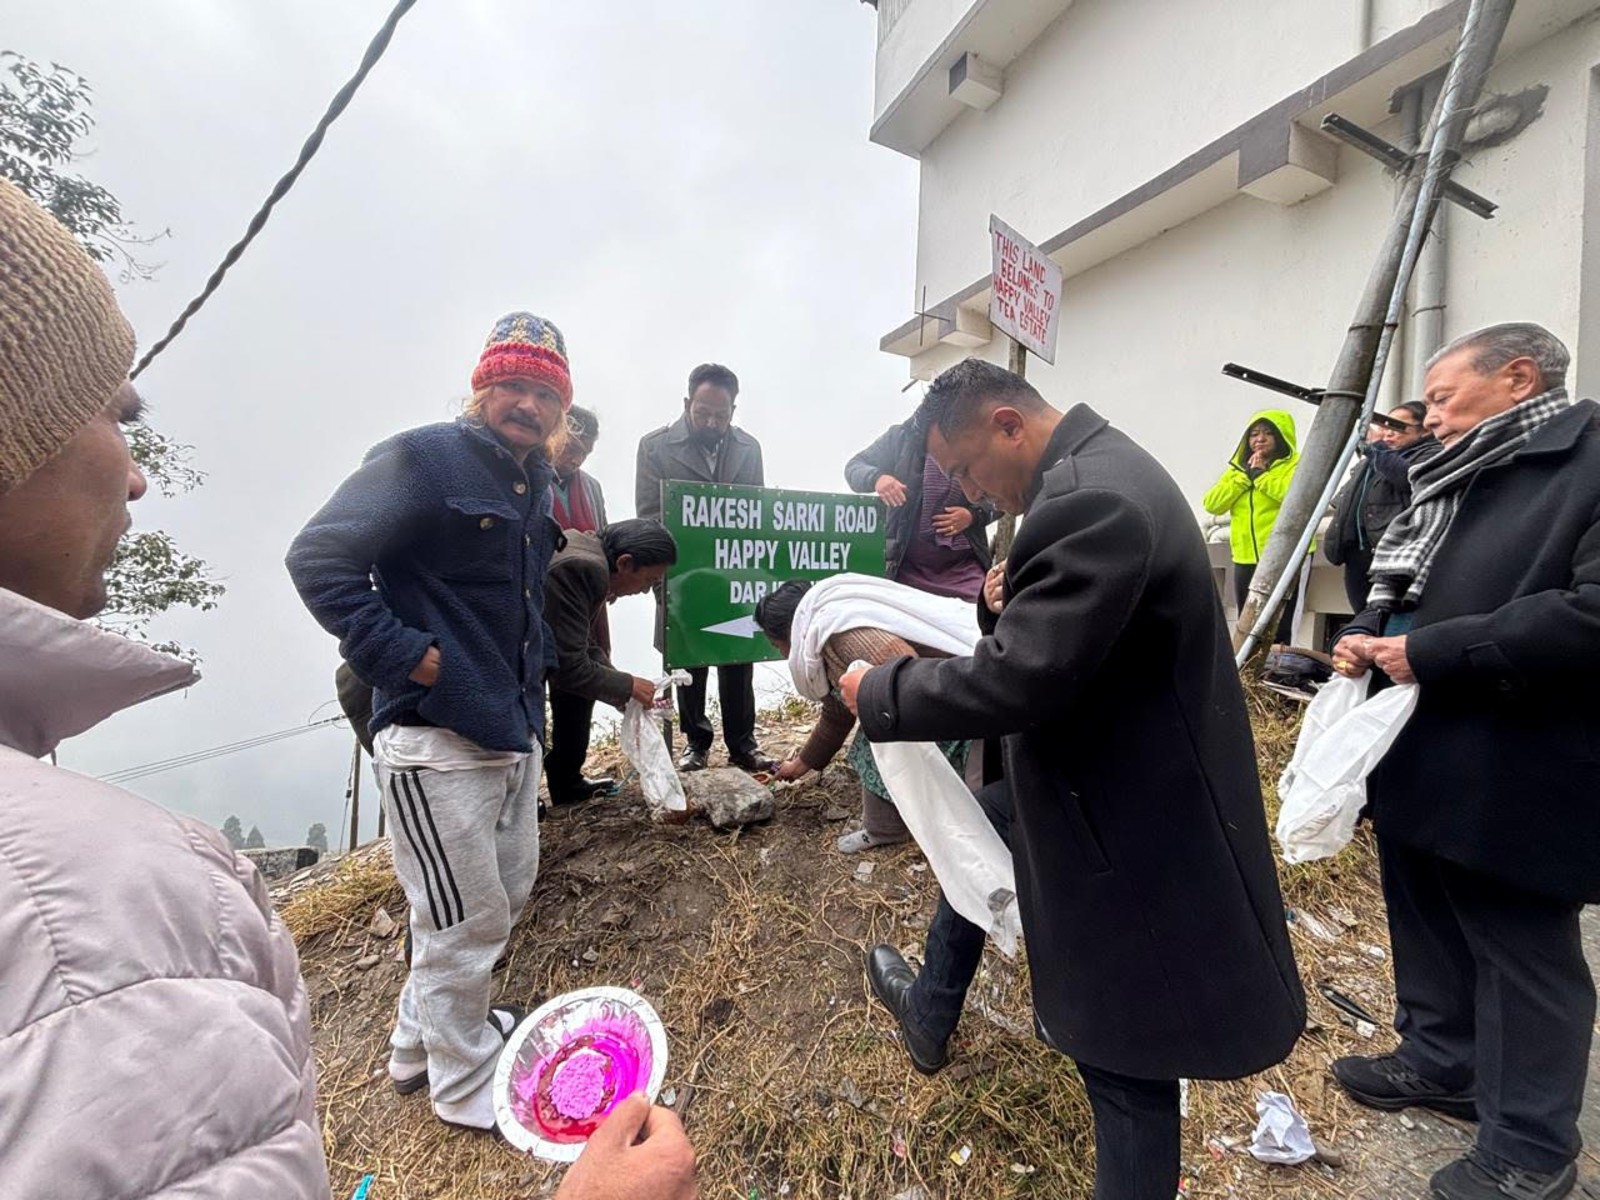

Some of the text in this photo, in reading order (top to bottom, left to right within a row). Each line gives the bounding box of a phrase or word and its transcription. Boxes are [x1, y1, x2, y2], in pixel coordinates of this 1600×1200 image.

[994, 230, 1046, 284] THIS LAND
[993, 272, 1051, 329] HAPPY VALLEY
[1000, 258, 1055, 311] BELONGS TO
[996, 295, 1047, 345] TEA ESTATE
[681, 494, 878, 533] RAKESH SARKI ROAD
[715, 538, 851, 570] HAPPY VALLEY
